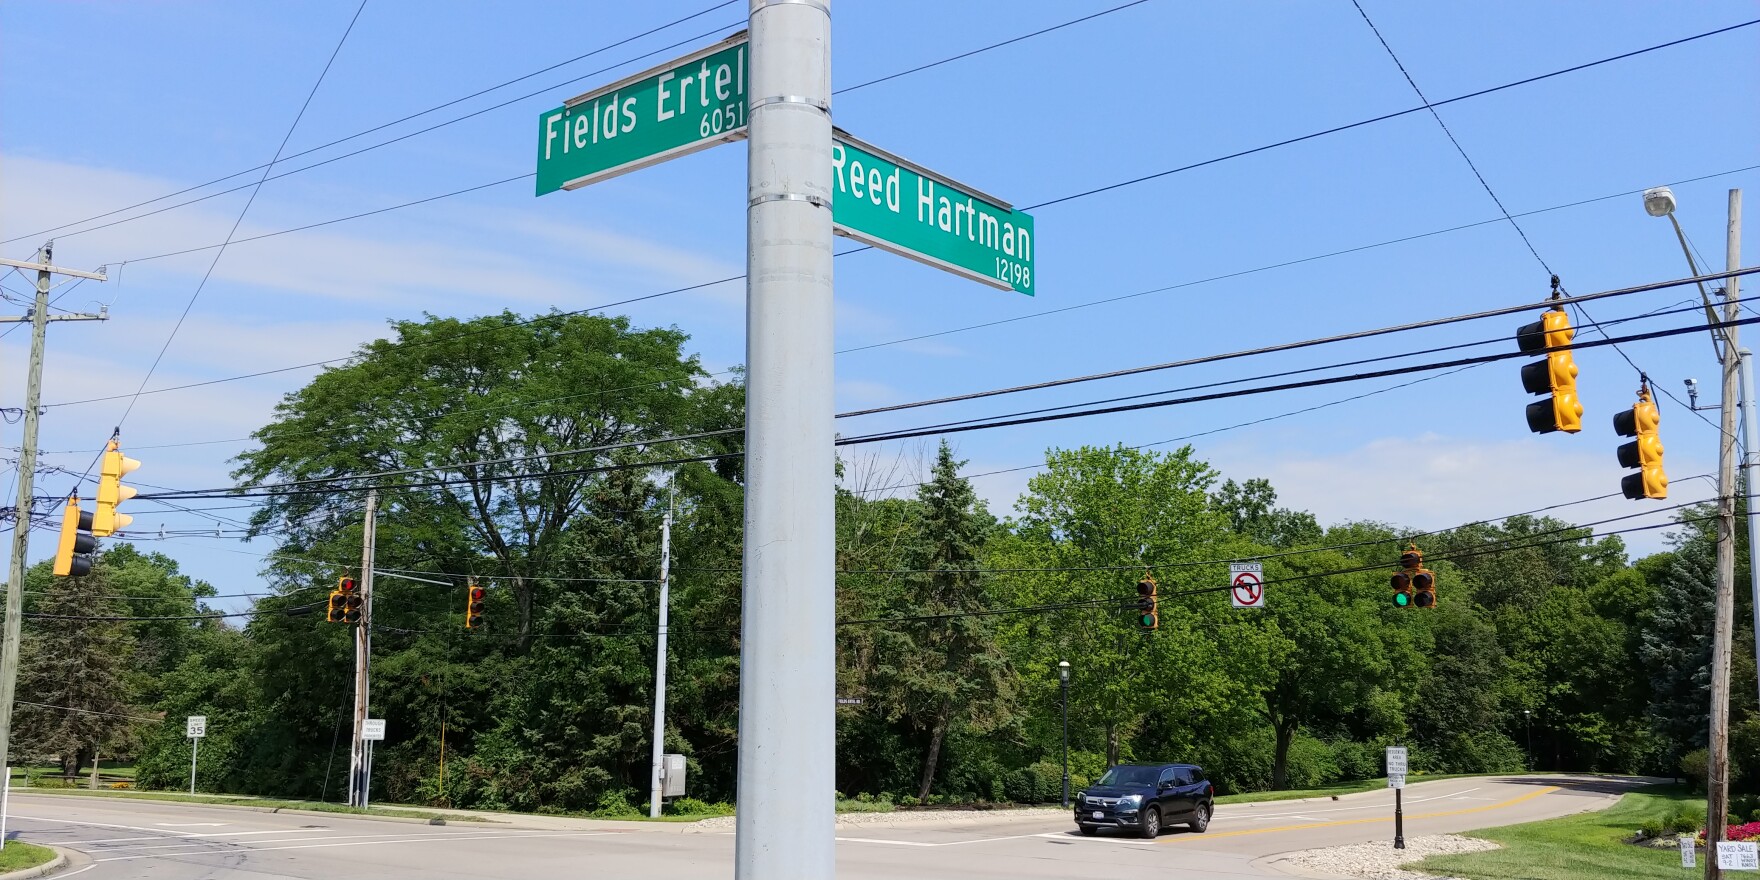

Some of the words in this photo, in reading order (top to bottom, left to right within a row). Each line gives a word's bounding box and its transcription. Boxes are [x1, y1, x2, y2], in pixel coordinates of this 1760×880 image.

[545, 92, 637, 160] Fields
[657, 46, 744, 122] Ertel
[700, 101, 743, 138] 6051
[832, 140, 900, 214] Reed
[917, 176, 1030, 262] Hartman
[995, 256, 1030, 289] 12198
[190, 726, 204, 735] 35
[1737, 844, 1753, 852] SALE
